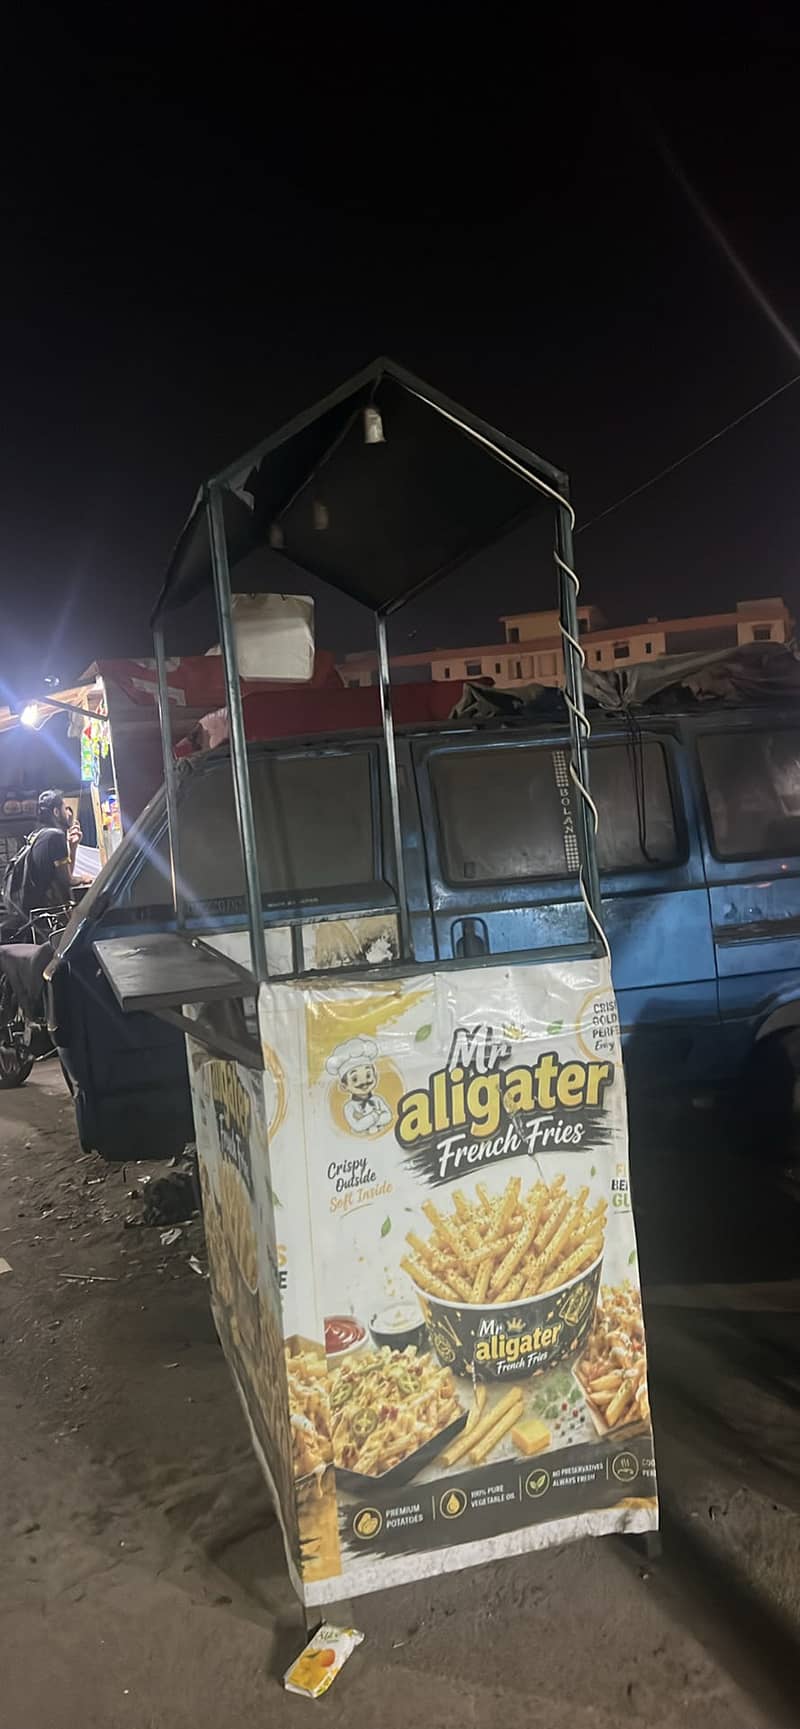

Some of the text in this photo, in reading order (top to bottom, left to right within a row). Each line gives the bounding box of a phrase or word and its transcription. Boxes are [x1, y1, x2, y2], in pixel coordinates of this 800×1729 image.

[560, 788, 574, 833] BOLAN
[448, 1023, 509, 1074] Mr
[398, 1053, 611, 1145] aligater
[436, 1115, 585, 1178] French Fries
[327, 1157, 367, 1181] Crispy
[336, 1168, 376, 1193] Outside
[330, 1181, 394, 1213] Soft Inside
[479, 1319, 503, 1338] Mr
[475, 1323, 562, 1362] aligater
[496, 1351, 549, 1375] French Fries
[552, 1476, 577, 1487] ALWAYS
[385, 1504, 420, 1518] PREMIUM
[471, 1494, 504, 1508] VEGETABLE
[386, 1514, 424, 1529] POTATOES
